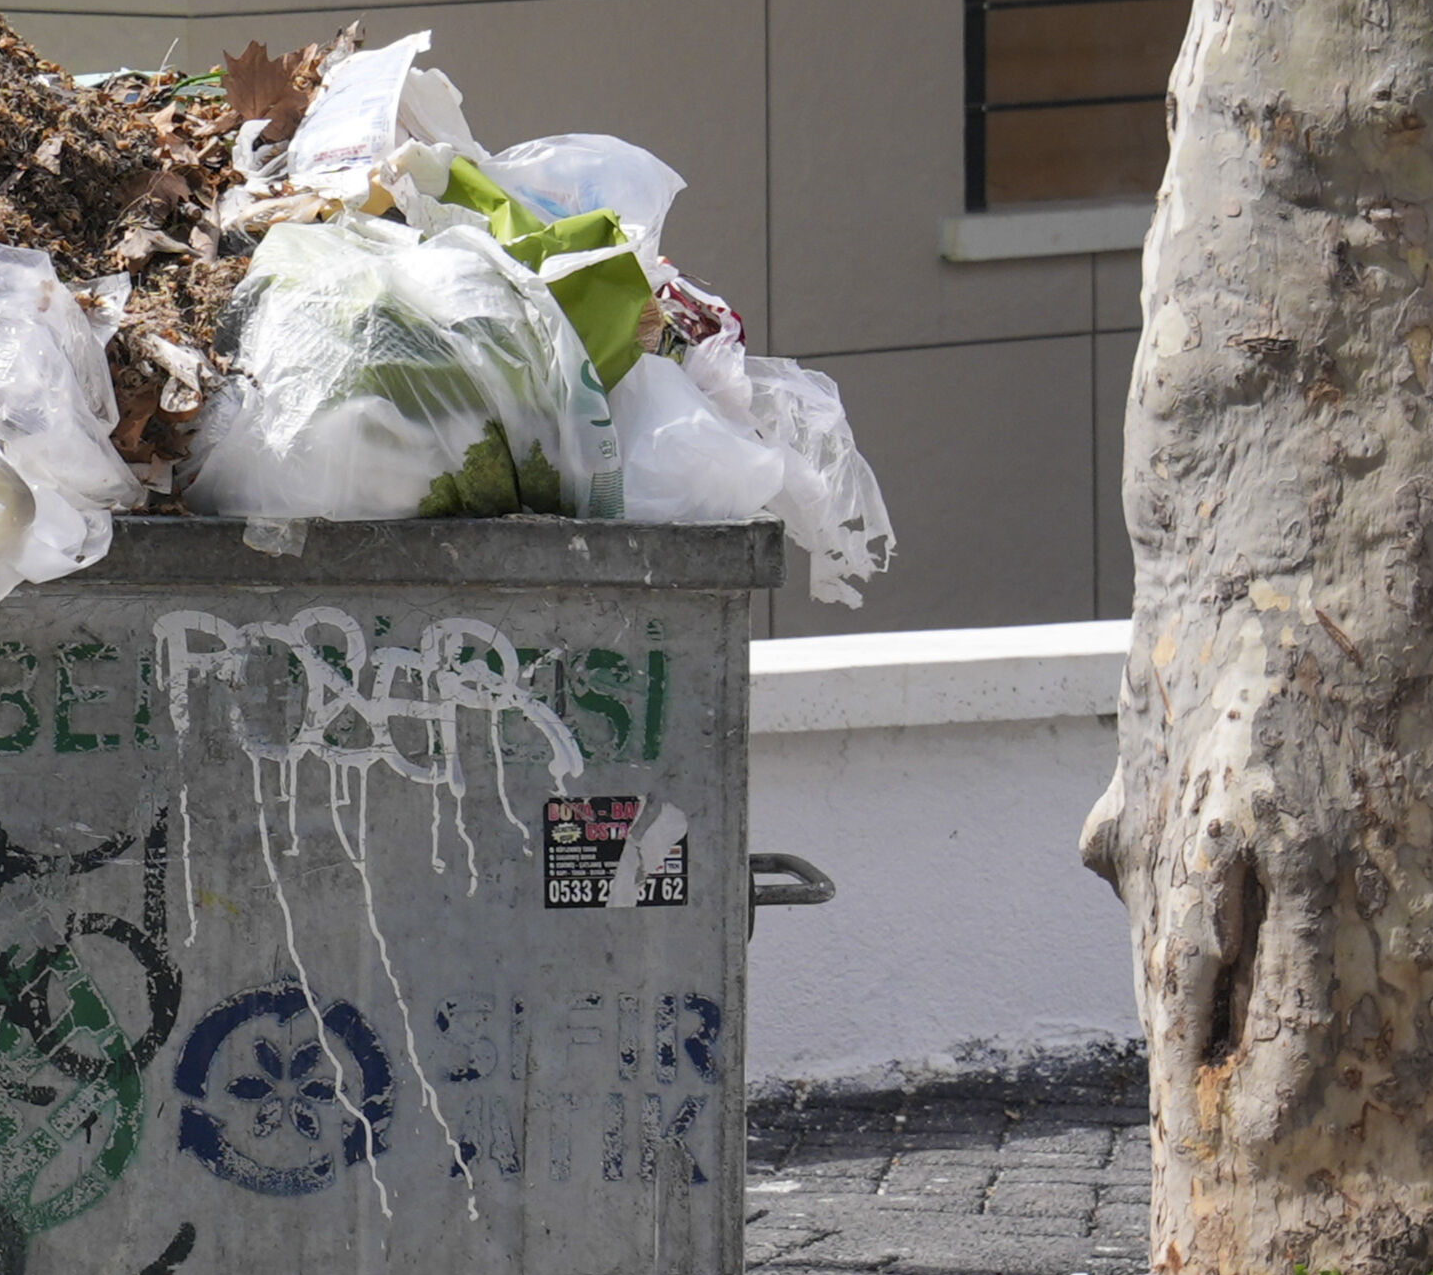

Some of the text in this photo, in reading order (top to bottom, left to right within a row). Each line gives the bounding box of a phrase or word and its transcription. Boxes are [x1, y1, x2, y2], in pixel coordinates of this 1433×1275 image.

[584, 821, 631, 842] USTA
[548, 879, 593, 904] 0533
[661, 877, 684, 902] 62
